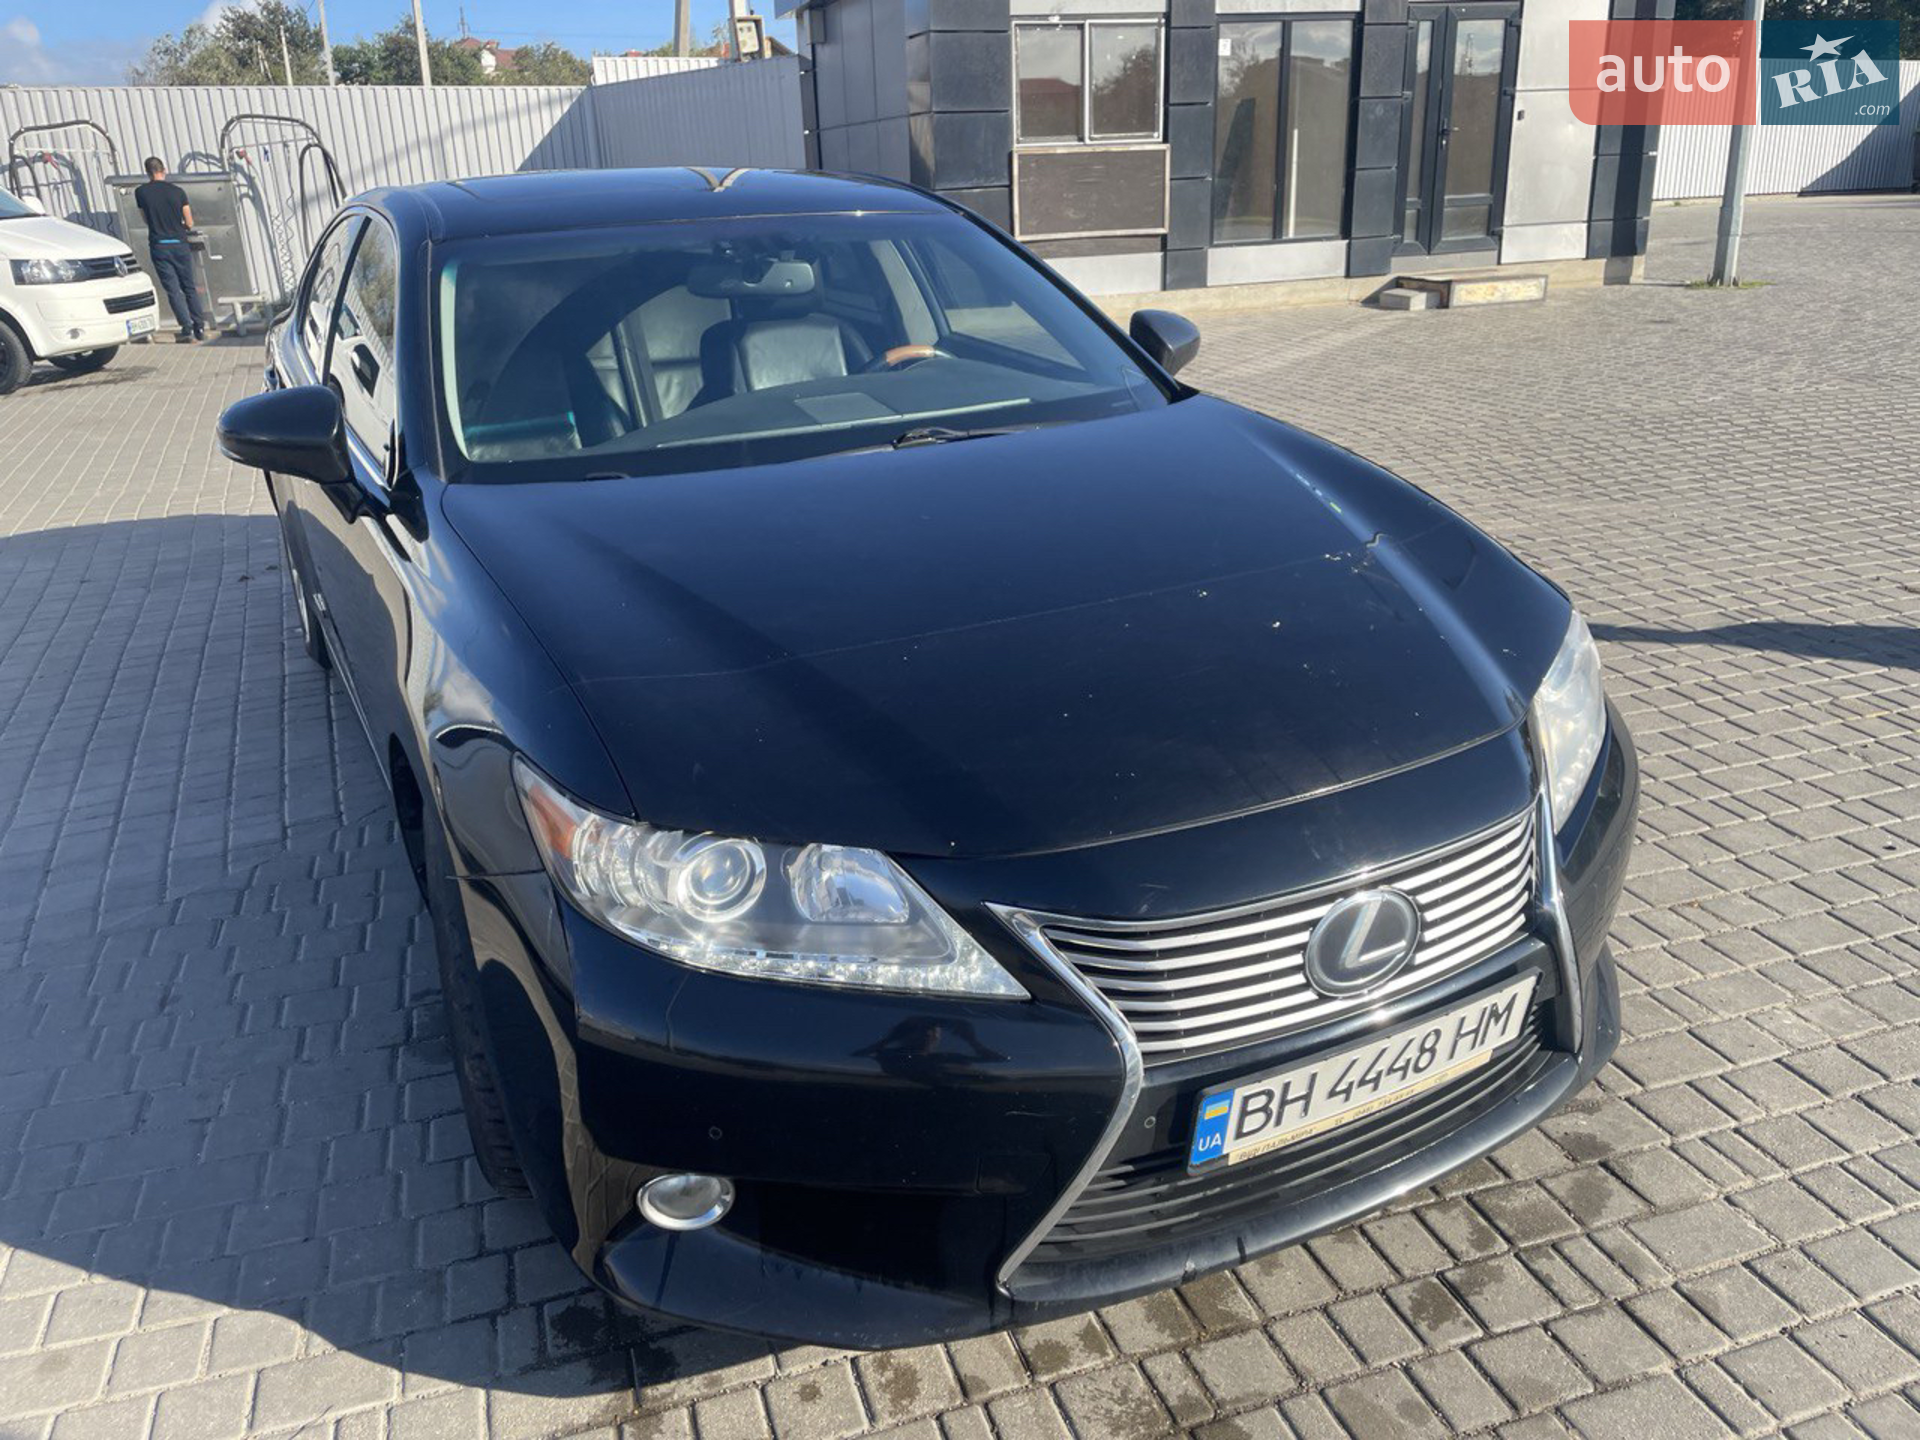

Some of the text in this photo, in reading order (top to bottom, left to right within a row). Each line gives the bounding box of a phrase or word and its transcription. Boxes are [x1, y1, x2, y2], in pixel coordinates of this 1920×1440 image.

[1234, 1072, 1318, 1141] BH
[1327, 1028, 1442, 1104] 4448
[1448, 991, 1520, 1060] HM
[1198, 1133, 1223, 1152] UA
